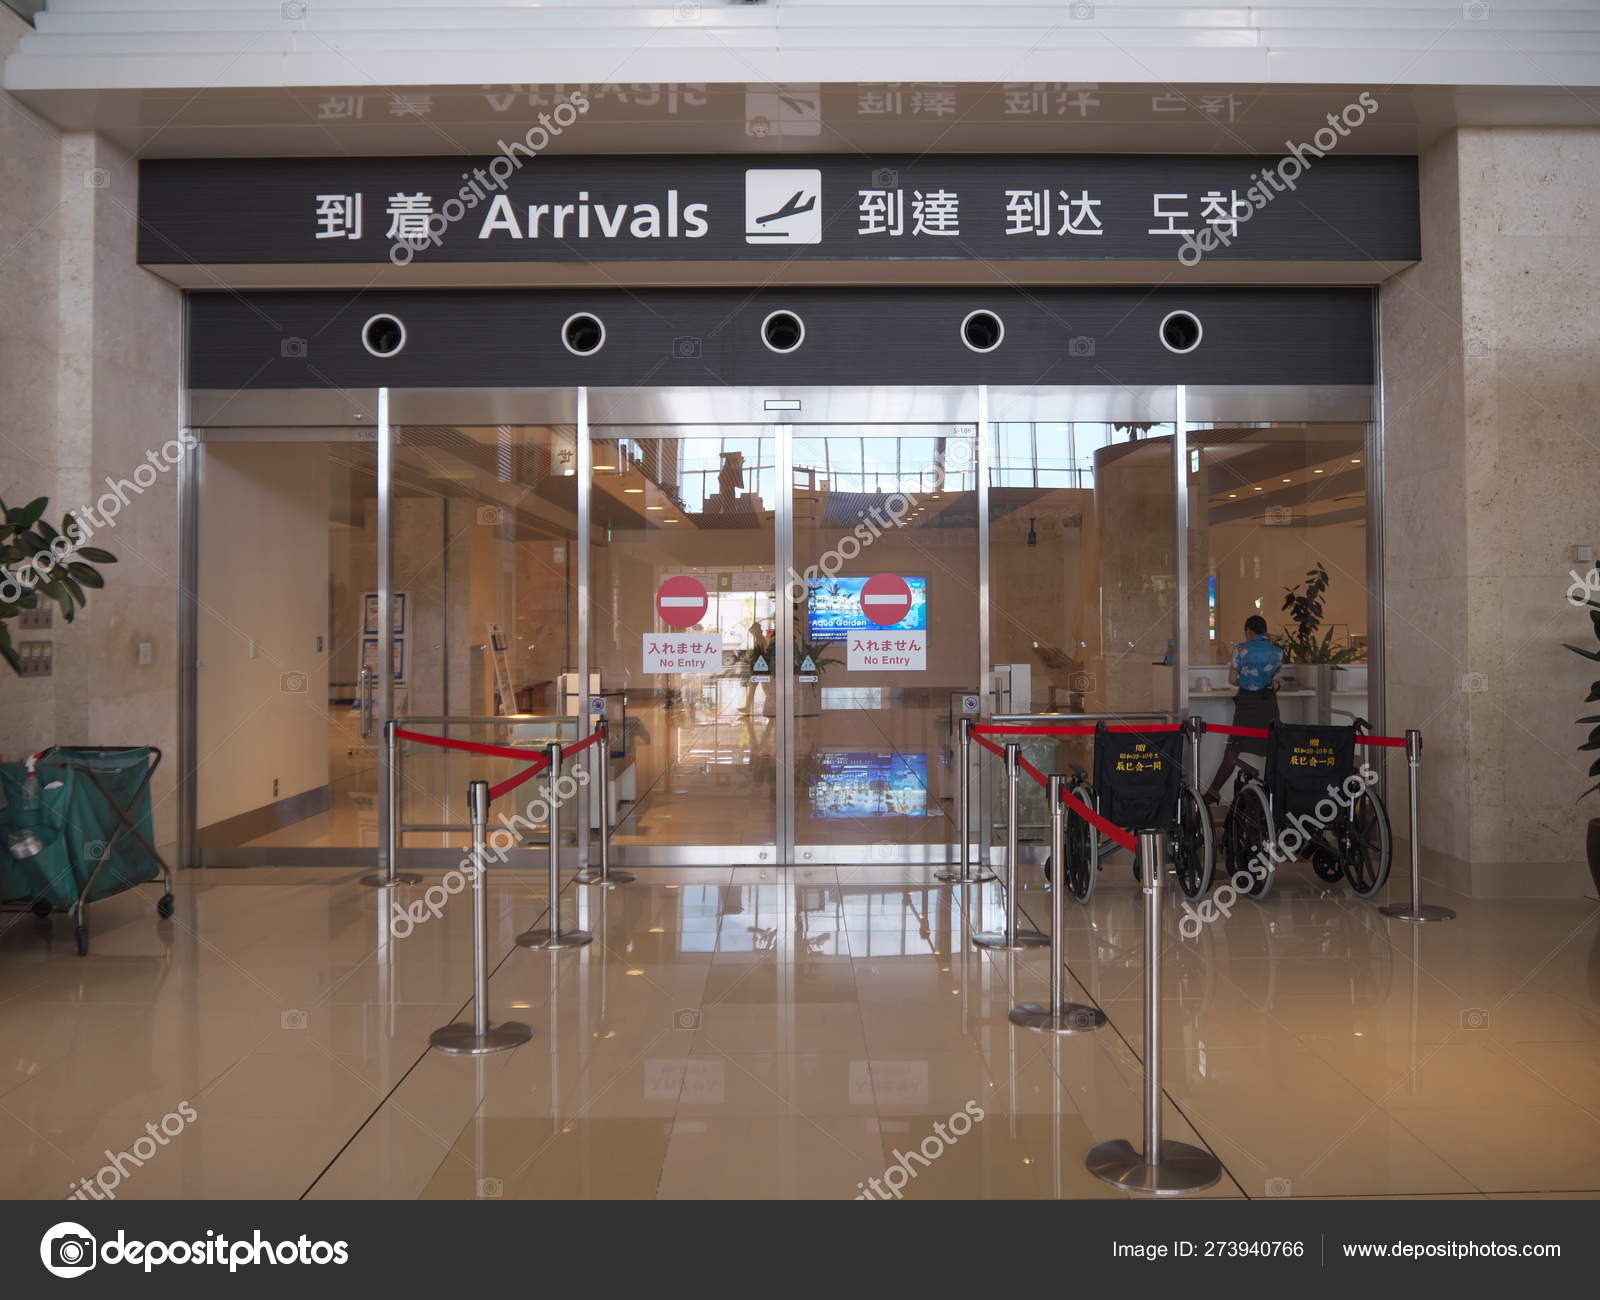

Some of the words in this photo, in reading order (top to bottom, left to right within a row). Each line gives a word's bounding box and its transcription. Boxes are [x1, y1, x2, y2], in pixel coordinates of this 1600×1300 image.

[478, 190, 709, 239] Arrivals
[857, 189, 960, 236] 到達
[1004, 189, 1104, 236] 到达
[1148, 189, 1245, 237] 도착
[648, 642, 717, 655] 入れません
[851, 639, 921, 652] 入れません
[659, 659, 674, 668] No
[677, 659, 706, 669] Entry
[864, 656, 879, 665] No
[881, 656, 910, 667] Entry
